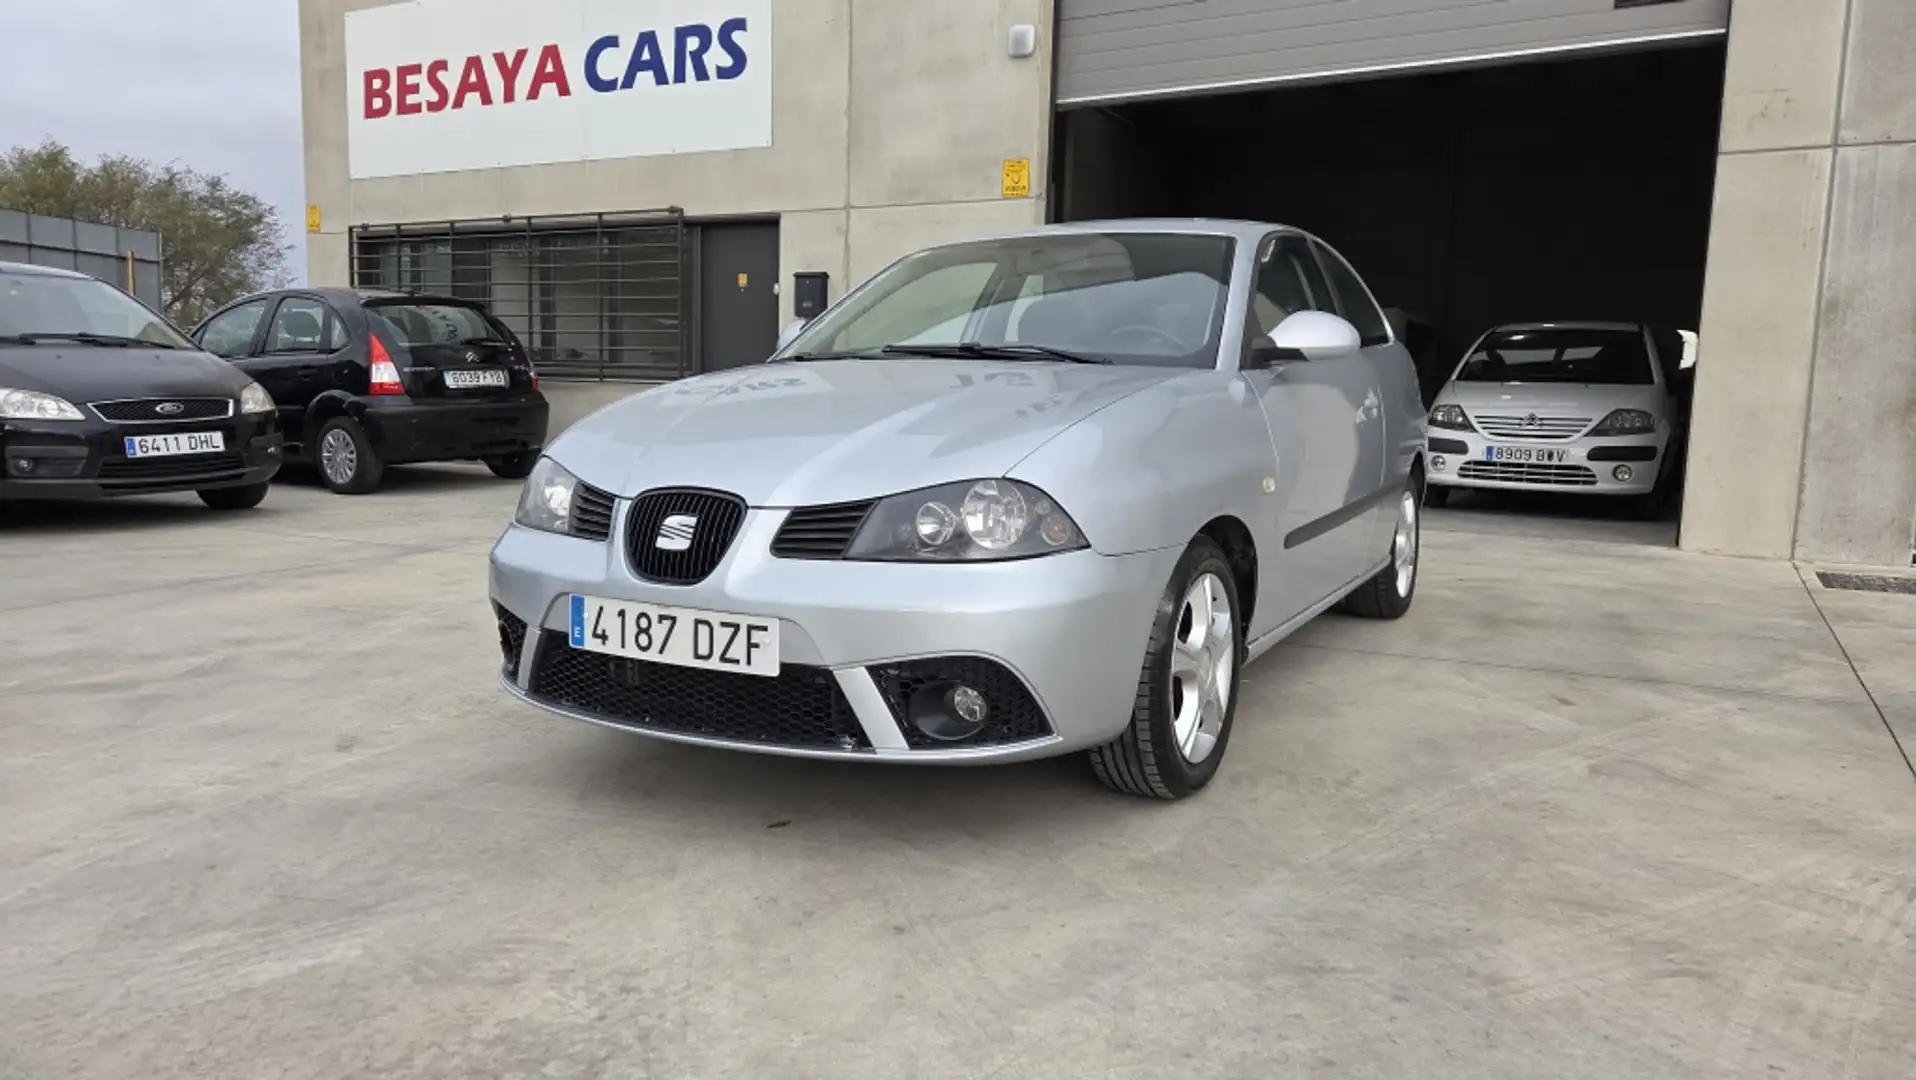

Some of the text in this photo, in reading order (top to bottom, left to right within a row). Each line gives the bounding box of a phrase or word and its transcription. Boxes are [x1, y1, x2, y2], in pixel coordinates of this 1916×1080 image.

[363, 17, 748, 119] BESAYA CARS
[138, 434, 220, 454] 6411 DHL
[1495, 447, 1532, 461] 8909
[574, 605, 769, 666] E 4187 DZF
